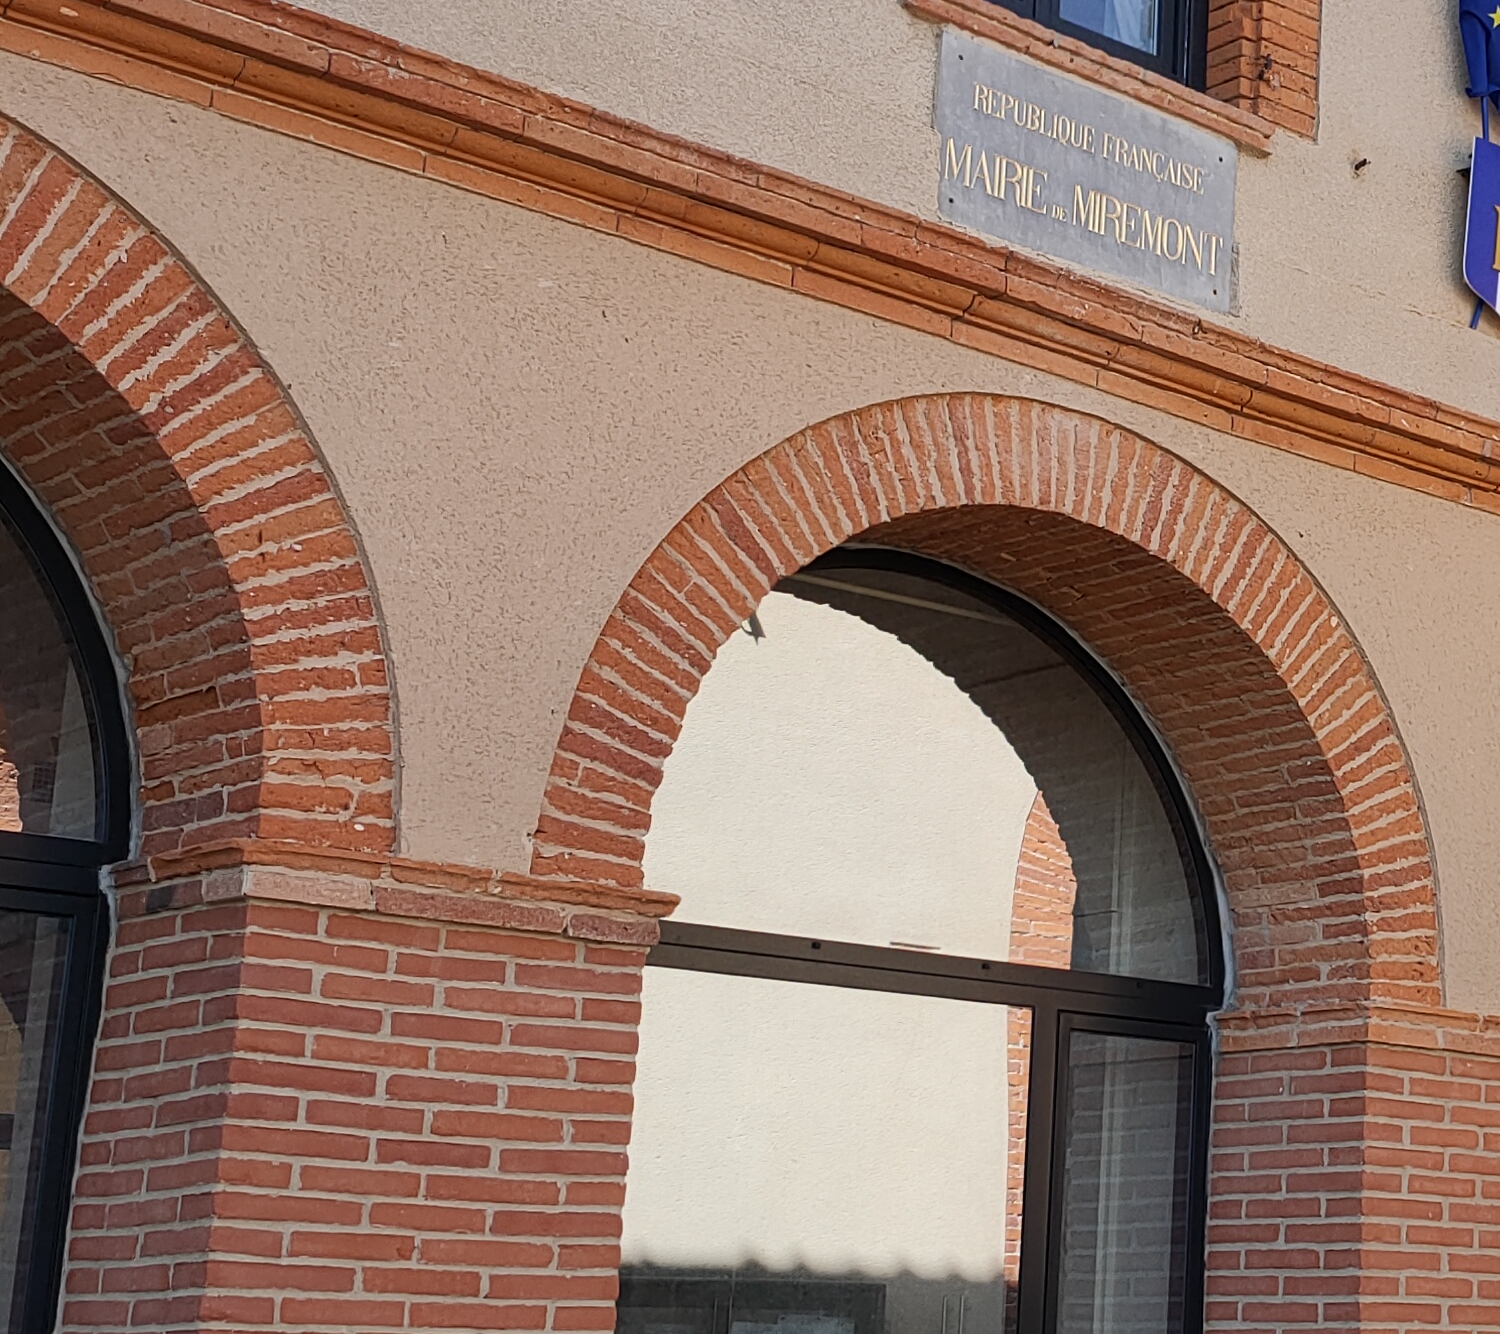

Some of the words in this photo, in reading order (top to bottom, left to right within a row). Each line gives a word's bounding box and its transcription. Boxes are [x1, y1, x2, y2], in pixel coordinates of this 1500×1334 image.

[973, 82, 1096, 154] REPUBLIQUE
[1102, 132, 1205, 196] FRANÇAISE
[943, 137, 1048, 215] MAIRIE
[1051, 203, 1067, 222] DE
[1072, 183, 1223, 276] MIREMONT
